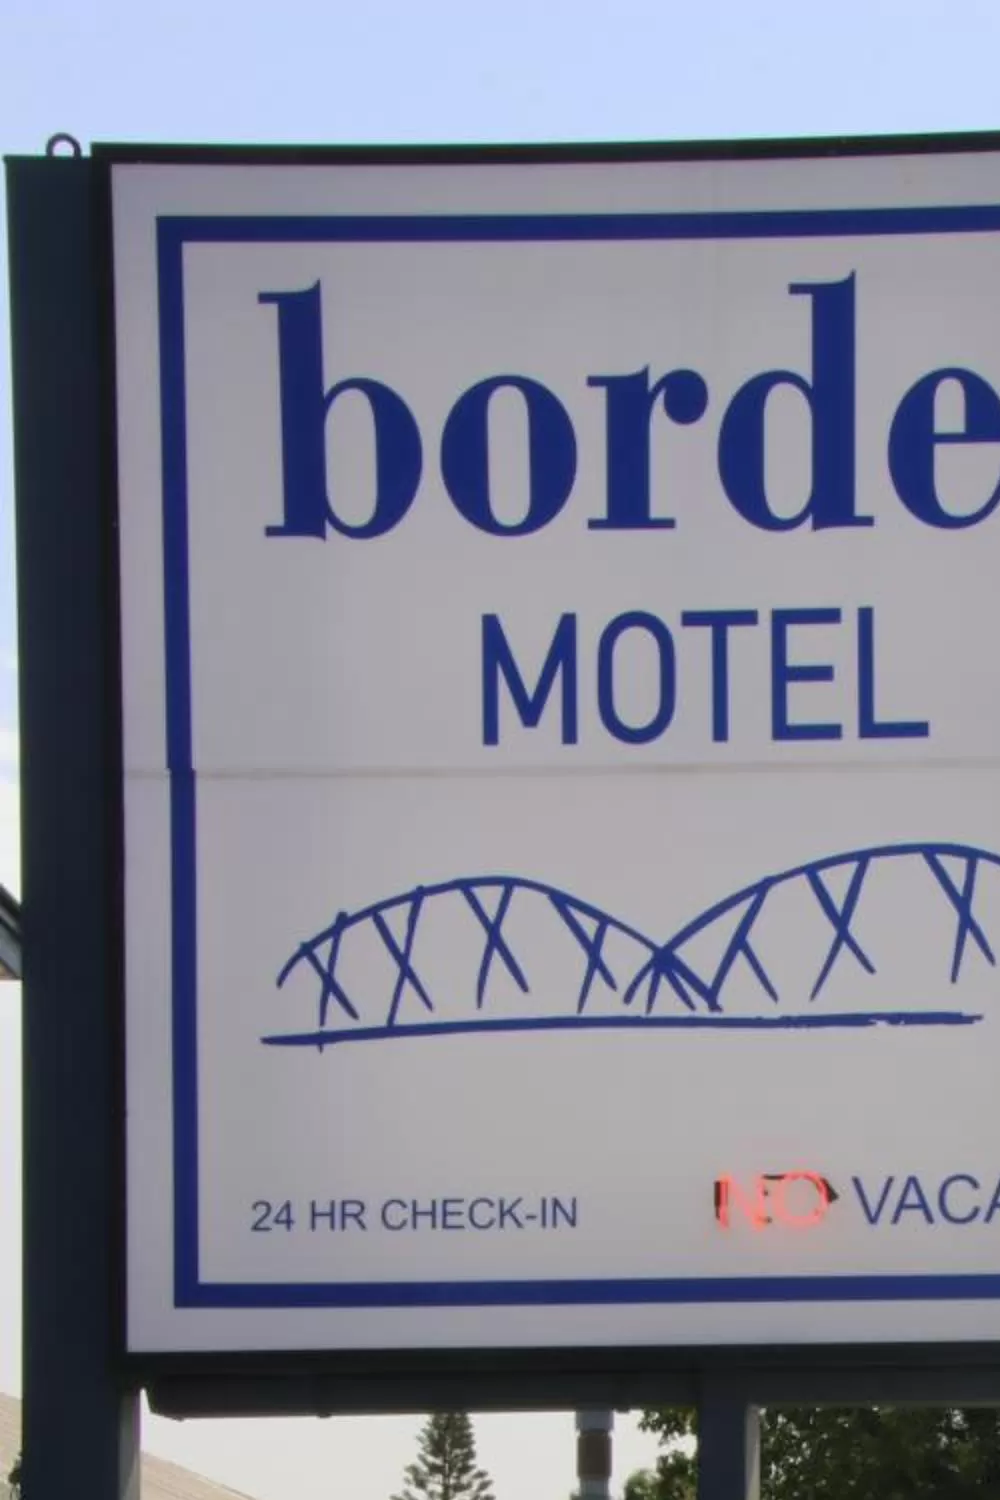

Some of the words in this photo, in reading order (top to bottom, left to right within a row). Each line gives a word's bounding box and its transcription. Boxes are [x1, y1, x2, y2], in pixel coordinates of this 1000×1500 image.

[482, 606, 929, 745] MOTEL
[250, 1199, 295, 1231] 24
[310, 1199, 367, 1231] HR
[381, 1197, 577, 1231] CHECK-IN
